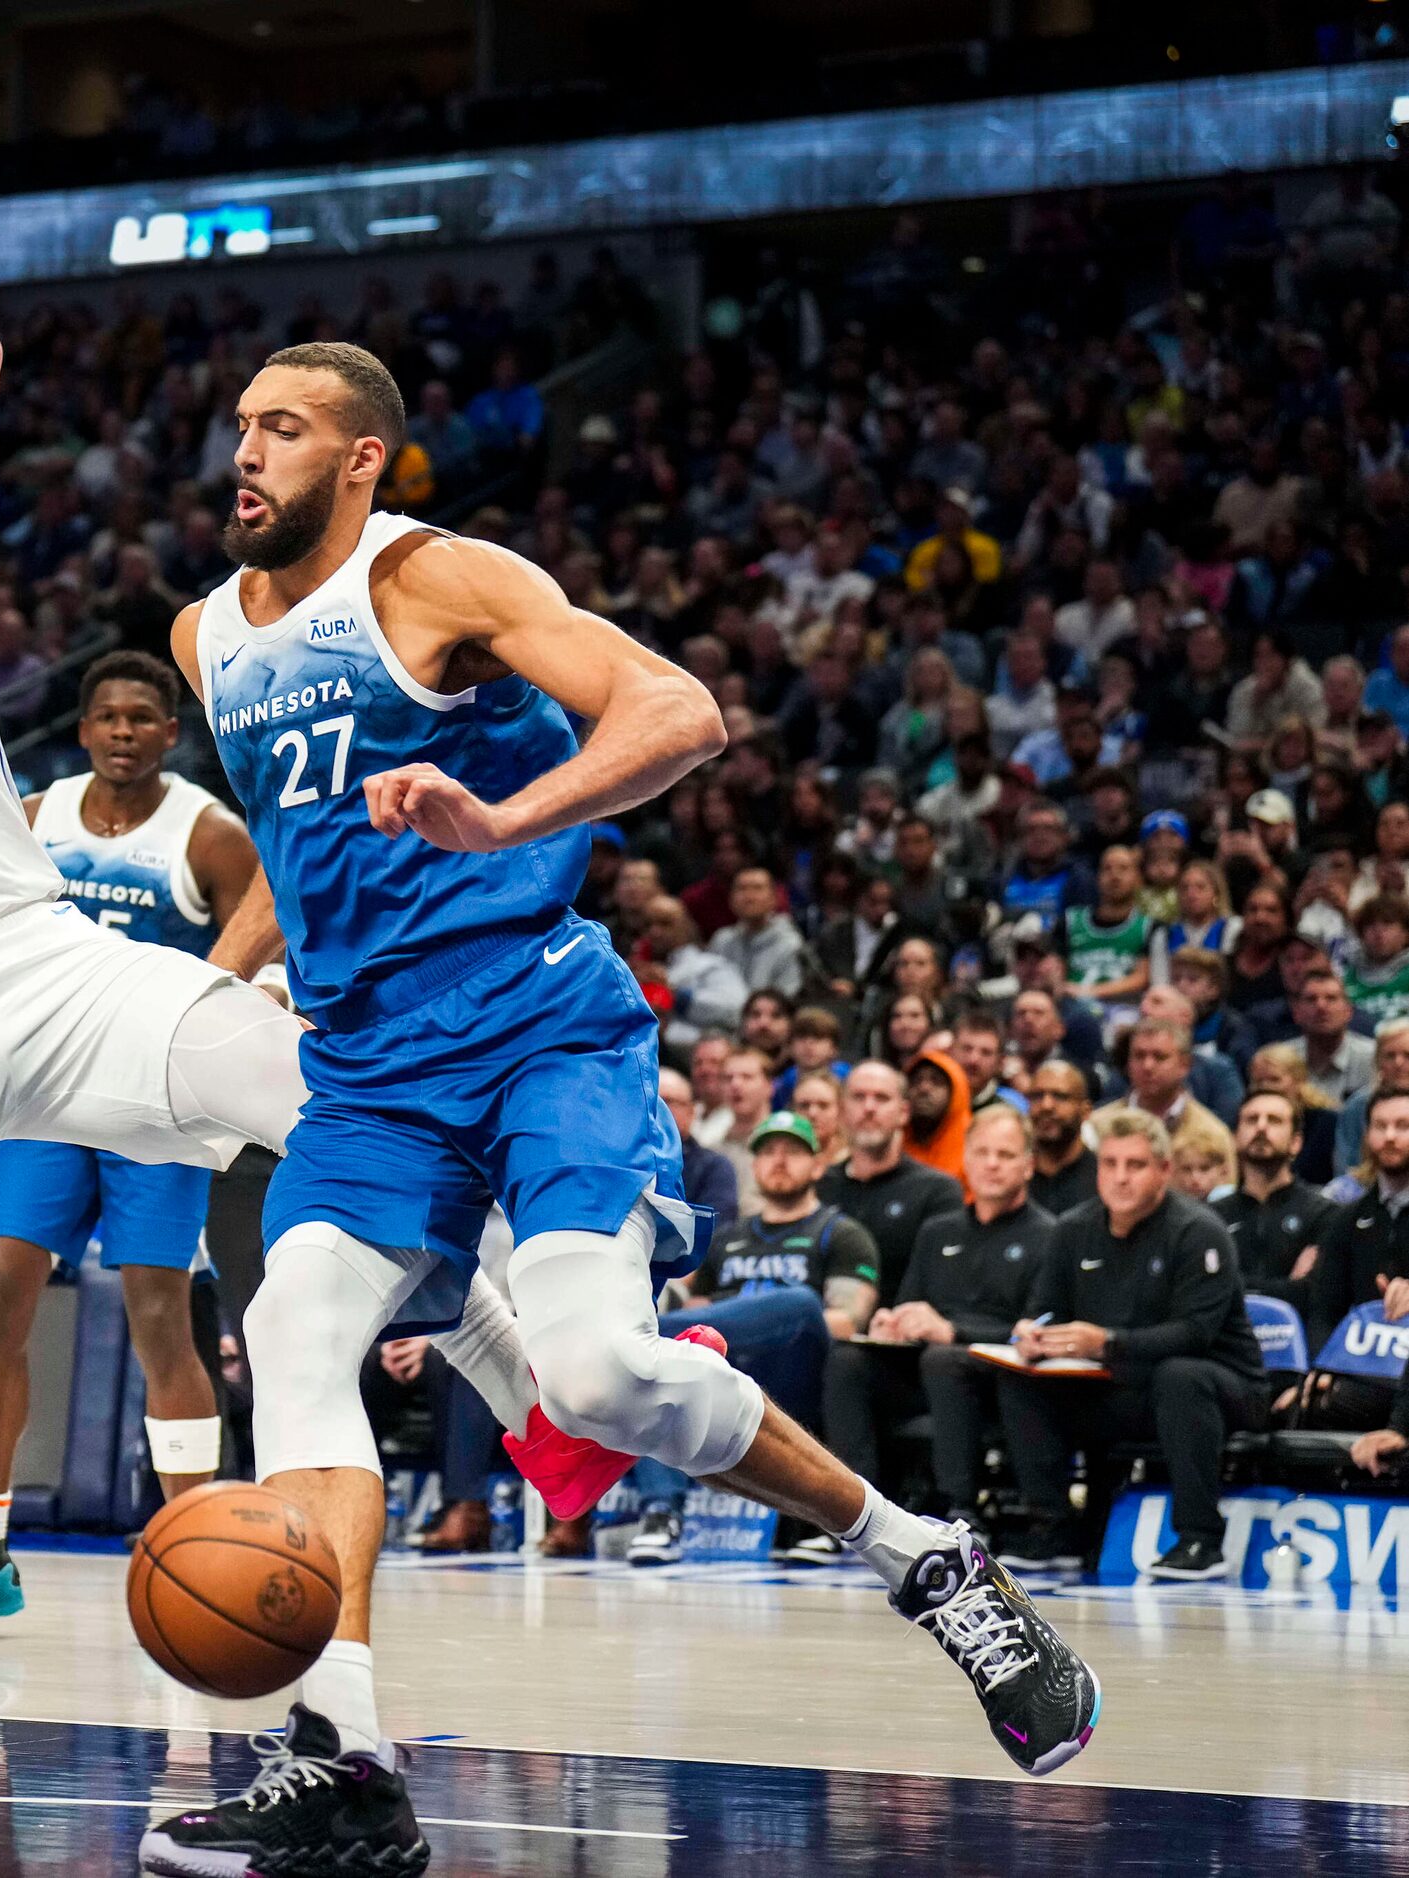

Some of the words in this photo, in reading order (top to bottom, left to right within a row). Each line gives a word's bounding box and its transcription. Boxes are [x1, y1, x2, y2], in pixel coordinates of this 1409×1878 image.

[218, 676, 354, 737] MINNESOTA
[271, 713, 355, 809] 27
[168, 1440, 185, 1453] 5
